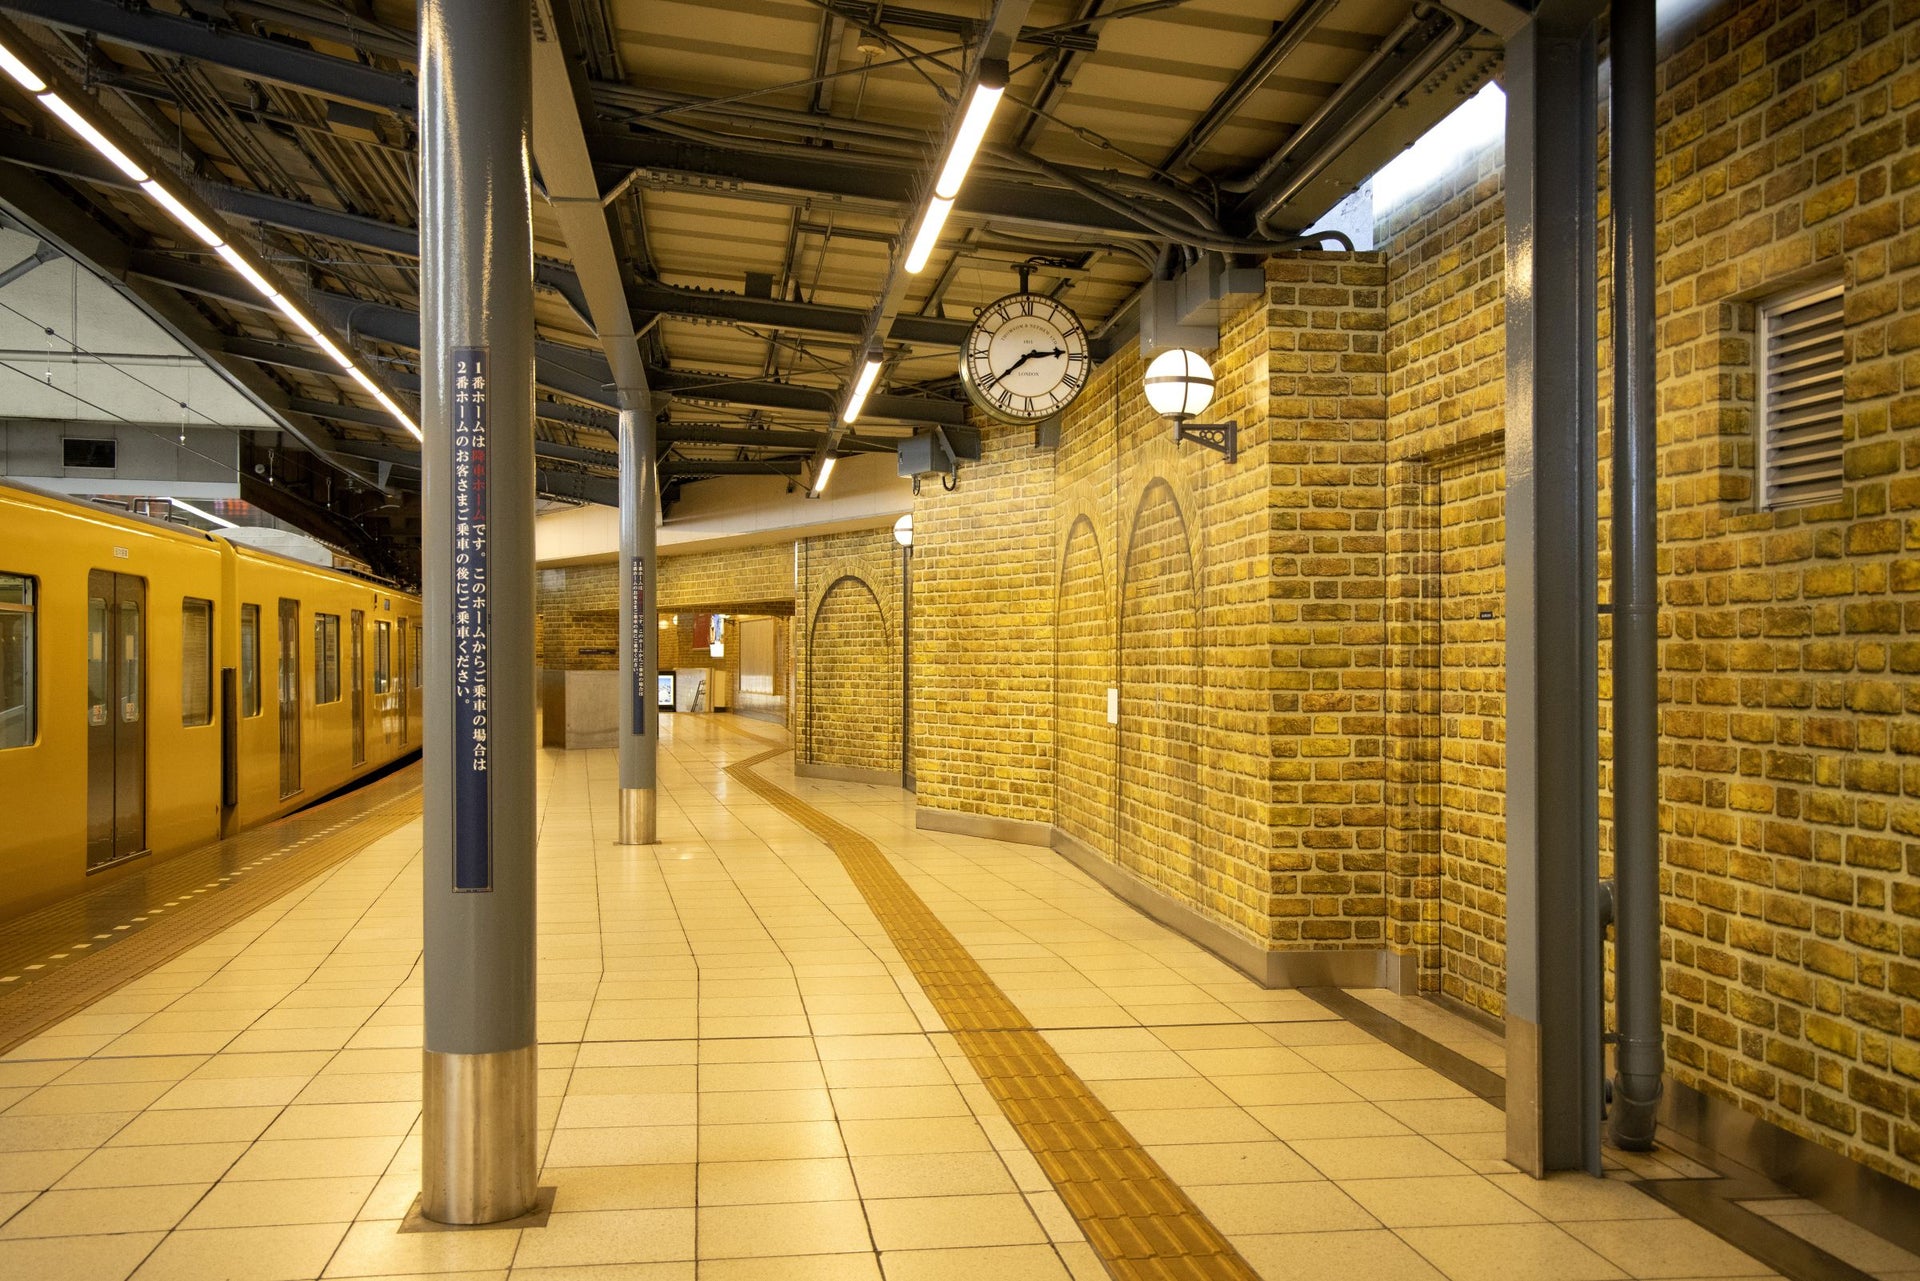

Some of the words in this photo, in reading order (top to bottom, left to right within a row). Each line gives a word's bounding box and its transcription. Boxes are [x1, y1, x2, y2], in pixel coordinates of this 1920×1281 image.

[996, 307, 1011, 324] XI
[1020, 301, 1034, 316] XII
[980, 326, 995, 338] X
[1062, 327, 1077, 339] II
[974, 350, 989, 360] IX
[1068, 353, 1083, 362] III
[998, 390, 1013, 407] VII
[1024, 396, 1035, 411] VI
[1048, 391, 1060, 406] V
[456, 362, 470, 705] 2番ホームのお客さまご乗車の後にご乗車ください。
